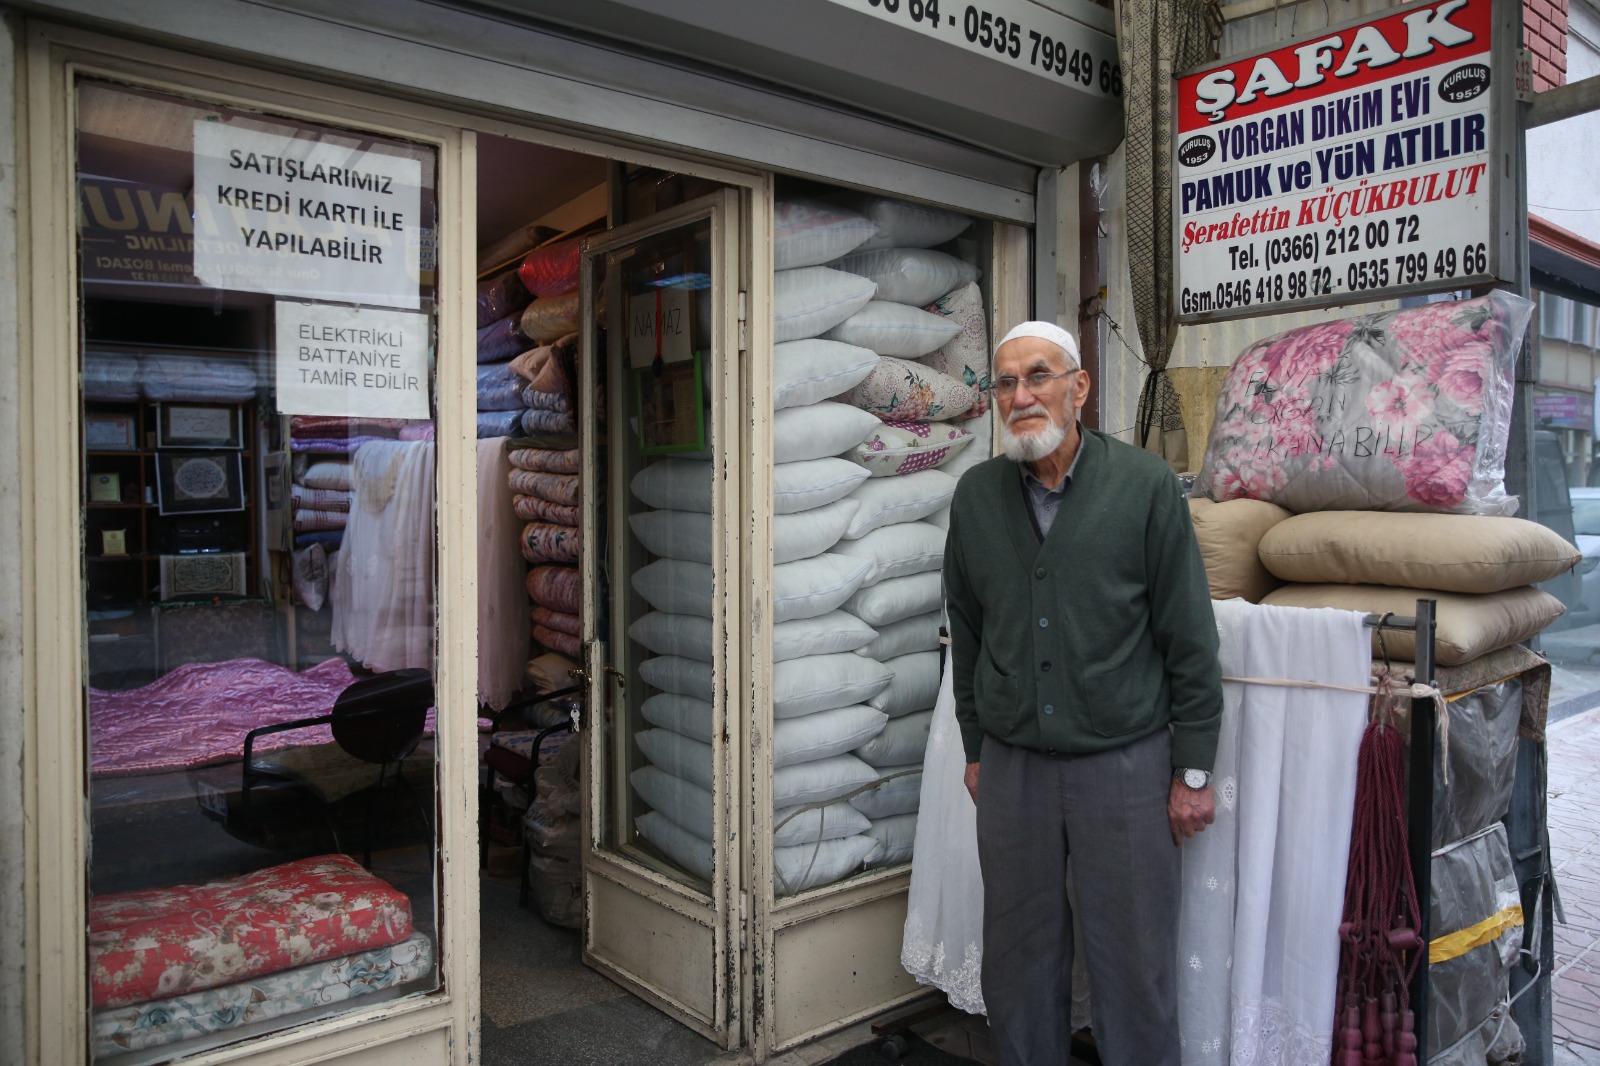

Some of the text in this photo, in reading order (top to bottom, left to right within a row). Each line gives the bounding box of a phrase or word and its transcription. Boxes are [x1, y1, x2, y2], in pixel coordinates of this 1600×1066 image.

[964, 5, 1021, 59] 0535
[1098, 60, 1122, 97] 66
[1195, 0, 1475, 121] ŞAFAK
[1443, 68, 1486, 91] KURULUŞ
[1449, 85, 1481, 100] 1953
[1180, 138, 1211, 156] KURULUŞ
[1186, 152, 1208, 164] 1953
[1218, 109, 1305, 163] YORGAN
[229, 148, 394, 195] SATIŞLARIMIZ
[1182, 163, 1273, 215] PAMUK
[1277, 160, 1312, 194] ve
[1383, 113, 1486, 171] ATILIR
[217, 184, 404, 232] KREDİ KARTI İLE
[1182, 163, 1486, 253] Şerafettin KÜÇÜKBULUT
[241, 226, 384, 265] YAPILABİLİR
[1229, 214, 1420, 271] Tel. (0366) 212 00 72
[1256, 274, 1283, 303] 418
[1288, 271, 1307, 299] 98
[1312, 266, 1332, 296] 72
[1348, 258, 1389, 292] 0535
[1396, 252, 1428, 285] 799
[1434, 247, 1457, 278] 49
[1463, 242, 1487, 276] 66
[299, 324, 403, 348] ELEKTRİKLİ
[299, 346, 402, 368] BATTANİYE
[298, 368, 419, 391] TAMİR EDİLİR
